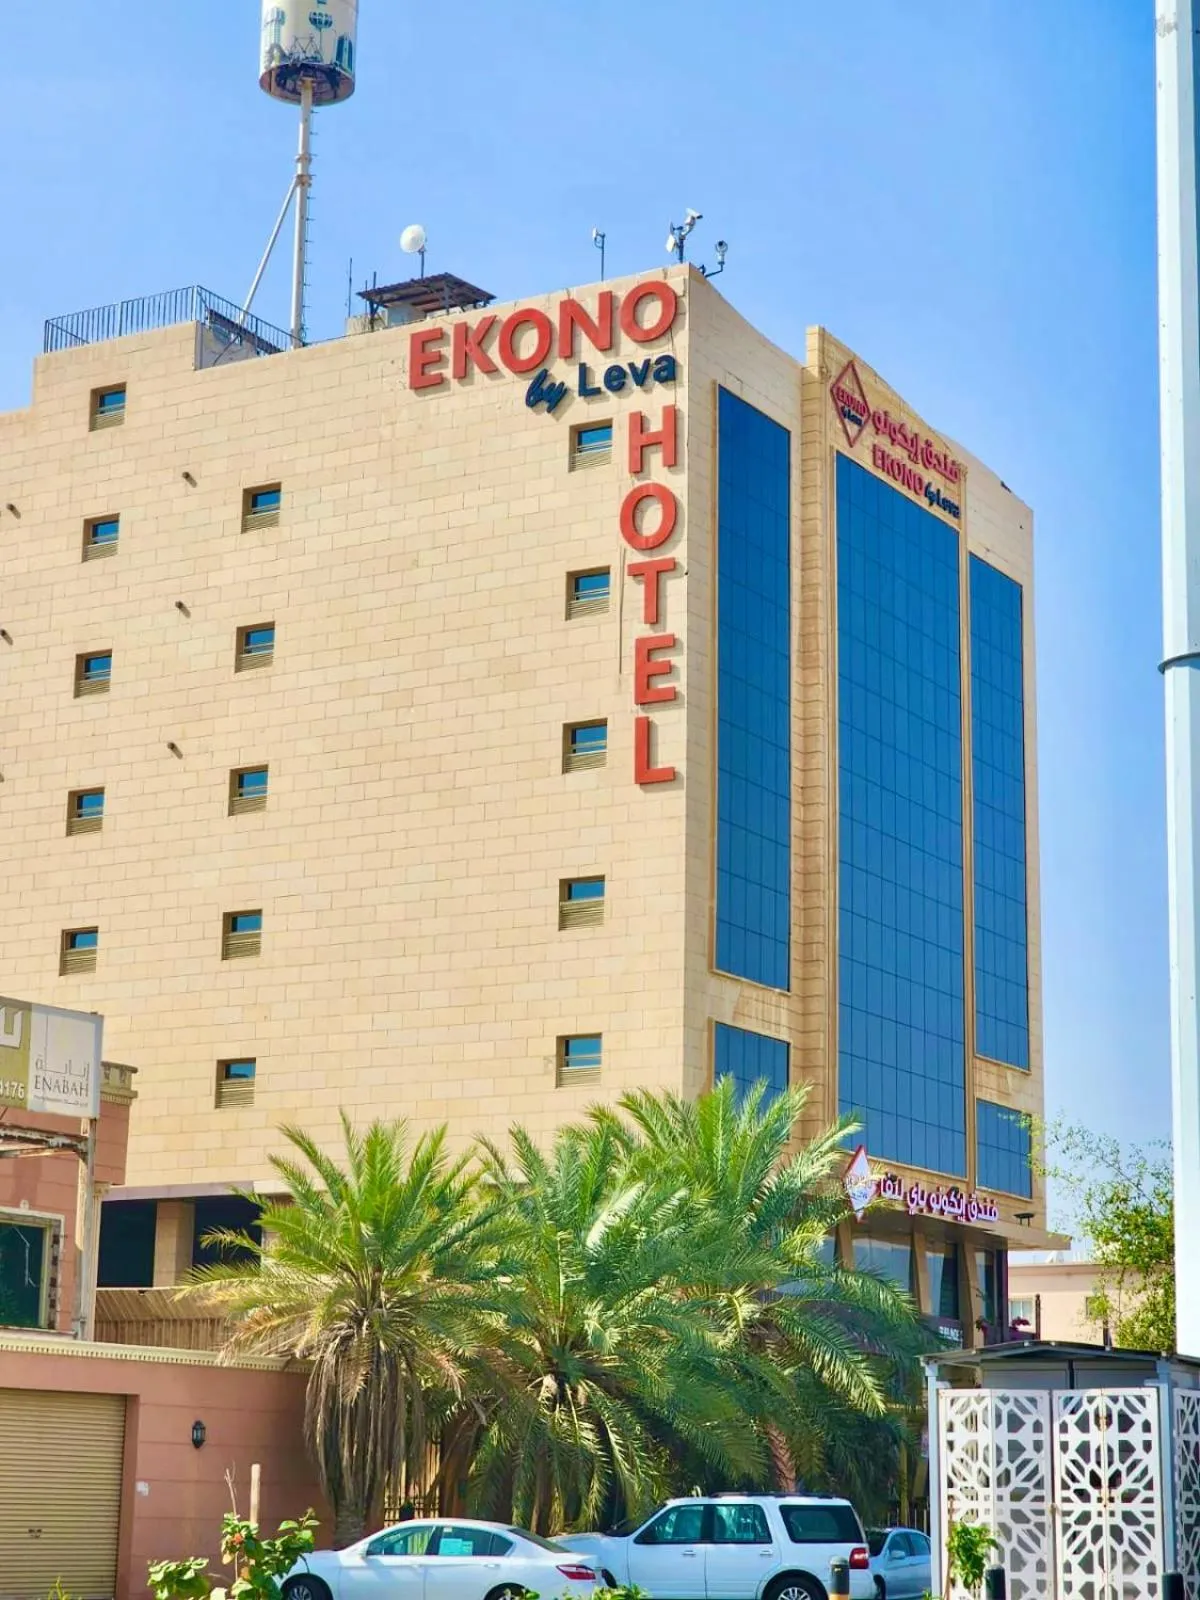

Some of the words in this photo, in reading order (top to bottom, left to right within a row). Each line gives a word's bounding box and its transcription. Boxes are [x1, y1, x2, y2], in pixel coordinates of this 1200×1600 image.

[409, 280, 678, 390] EKONO
[525, 368, 568, 414] by
[578, 354, 676, 397] Leva
[872, 443, 924, 496] EKONO
[619, 404, 678, 786] HOTEL
[34, 1074, 89, 1098] ENABAH
[907, 1183, 927, 1215] باي
[967, 1193, 999, 1222] فندق
